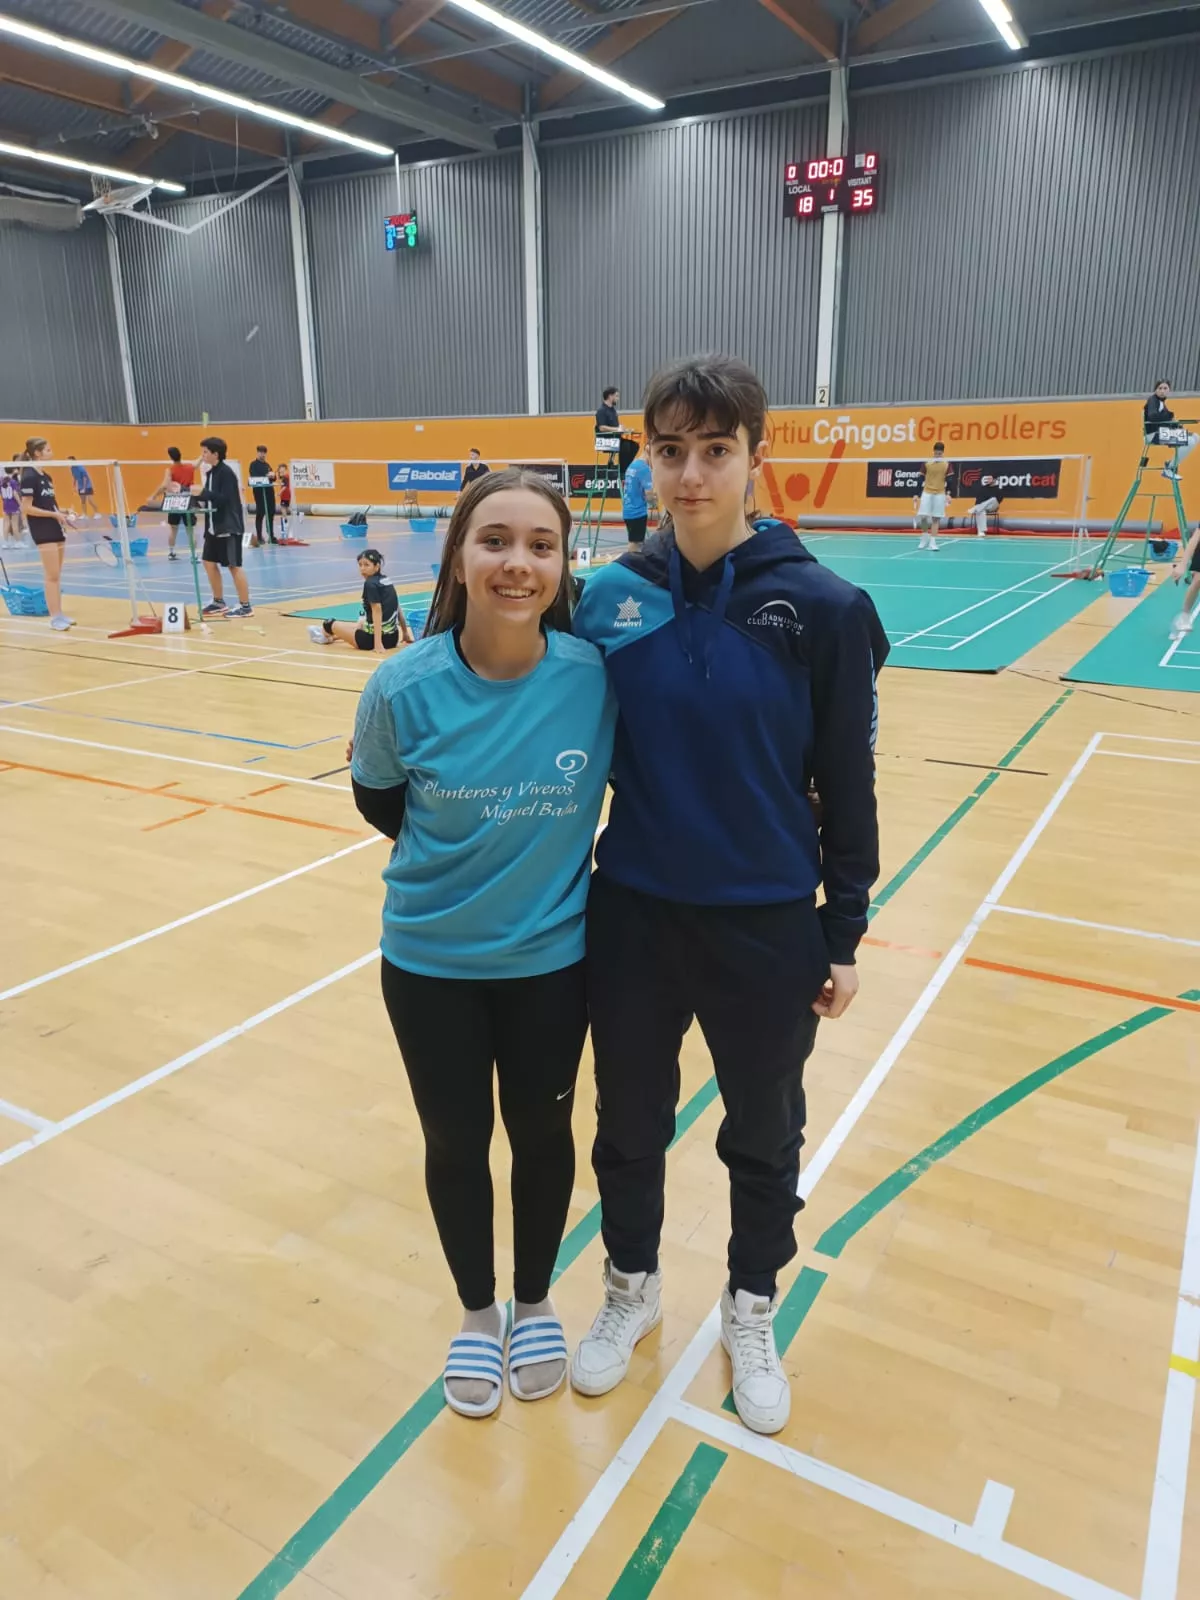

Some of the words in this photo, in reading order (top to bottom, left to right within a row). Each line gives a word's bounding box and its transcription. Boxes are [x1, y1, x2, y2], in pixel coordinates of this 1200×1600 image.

[808, 159, 843, 179] 00:0
[866, 155, 875, 168] 0
[788, 166, 796, 178] 0
[788, 185, 812, 194] LOCAL
[847, 177, 872, 187] VISITANT
[799, 196, 813, 213] 18
[853, 189, 873, 207] 35
[819, 389, 825, 403] 2
[813, 418, 917, 450] Congost
[918, 414, 1067, 442] Granollers
[410, 470, 459, 481] Babolat
[580, 551, 586, 561] 4
[168, 606, 178, 624] 8
[423, 780, 498, 800] Planteros
[499, 785, 512, 802] y
[518, 782, 574, 797] Viveros
[480, 801, 535, 825] Miguel
